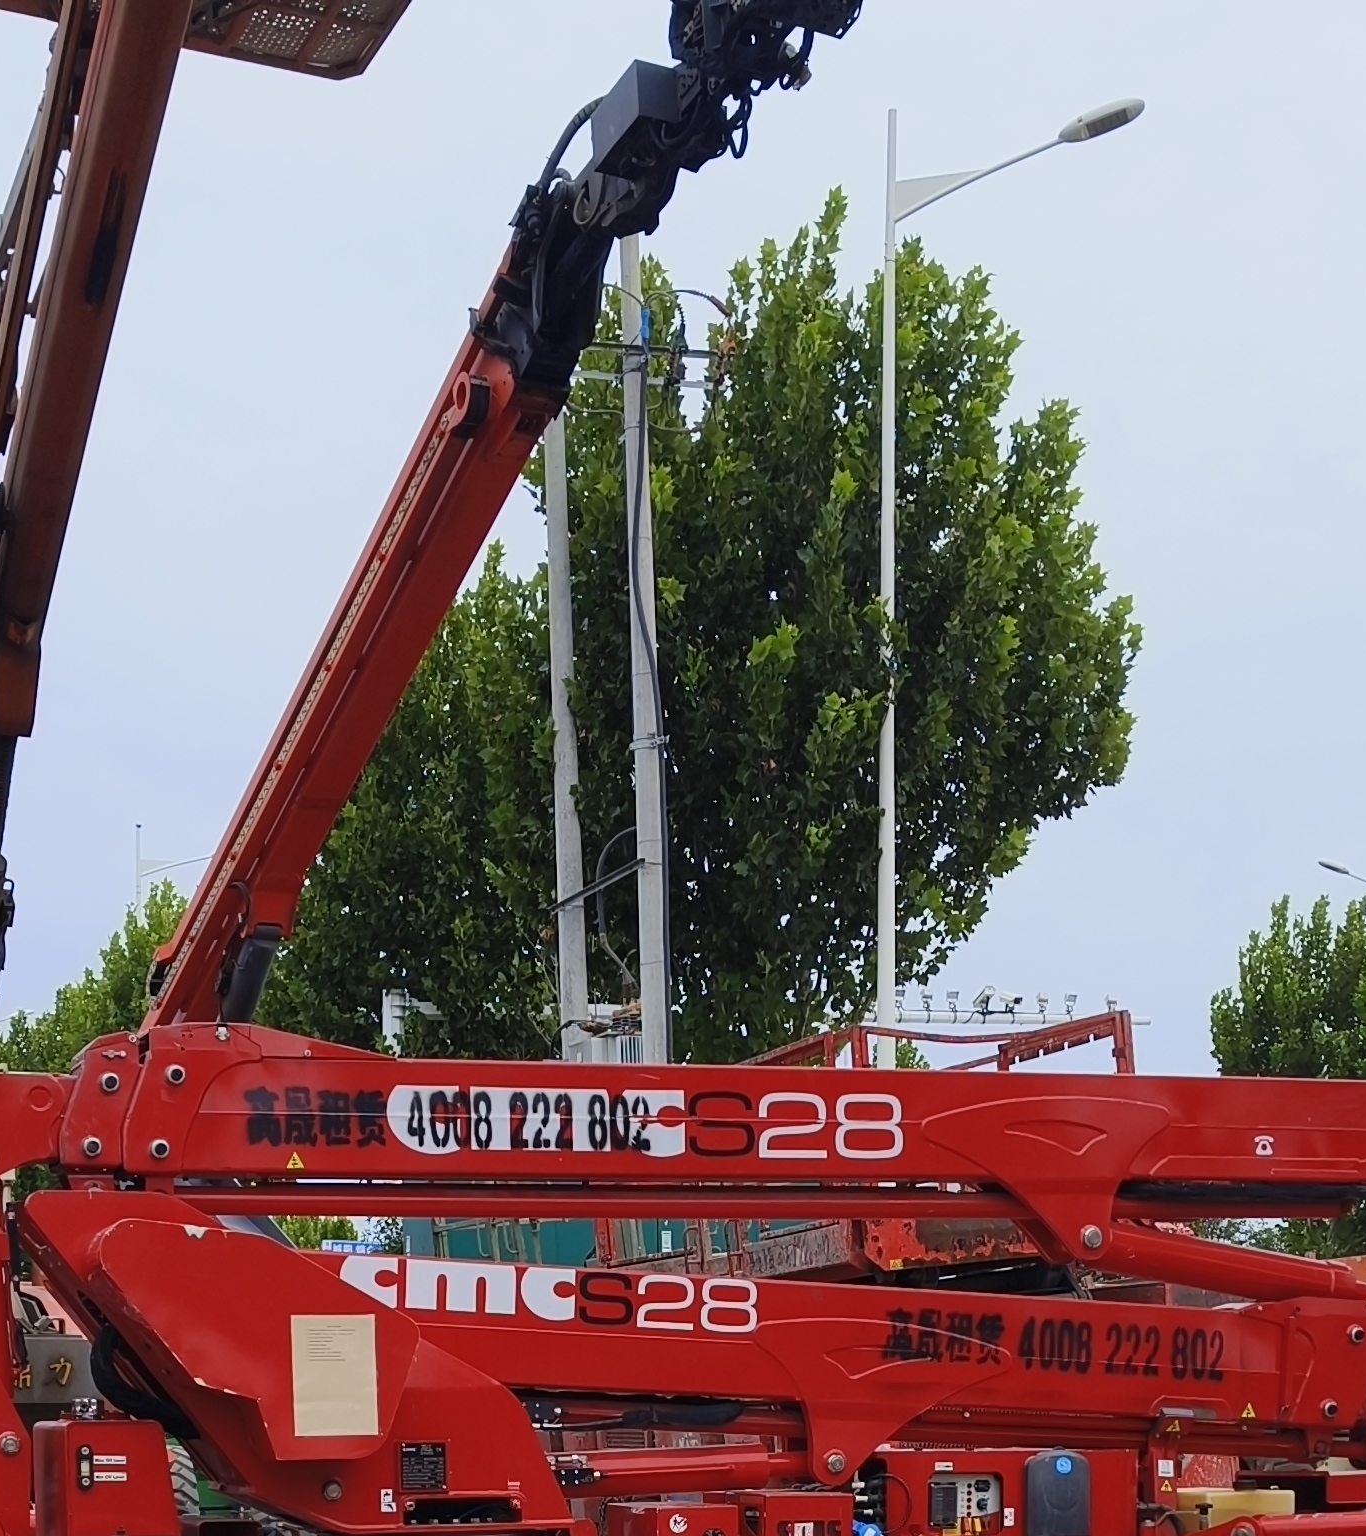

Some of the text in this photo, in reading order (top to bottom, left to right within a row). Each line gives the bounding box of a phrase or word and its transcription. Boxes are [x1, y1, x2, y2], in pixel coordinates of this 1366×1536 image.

[510, 1092, 574, 1150] 222
[589, 1094, 651, 1152] 802
[1019, 1316, 1093, 1374] 4008
[1105, 1323, 1160, 1377] 222
[1171, 1327, 1225, 1381] 802
